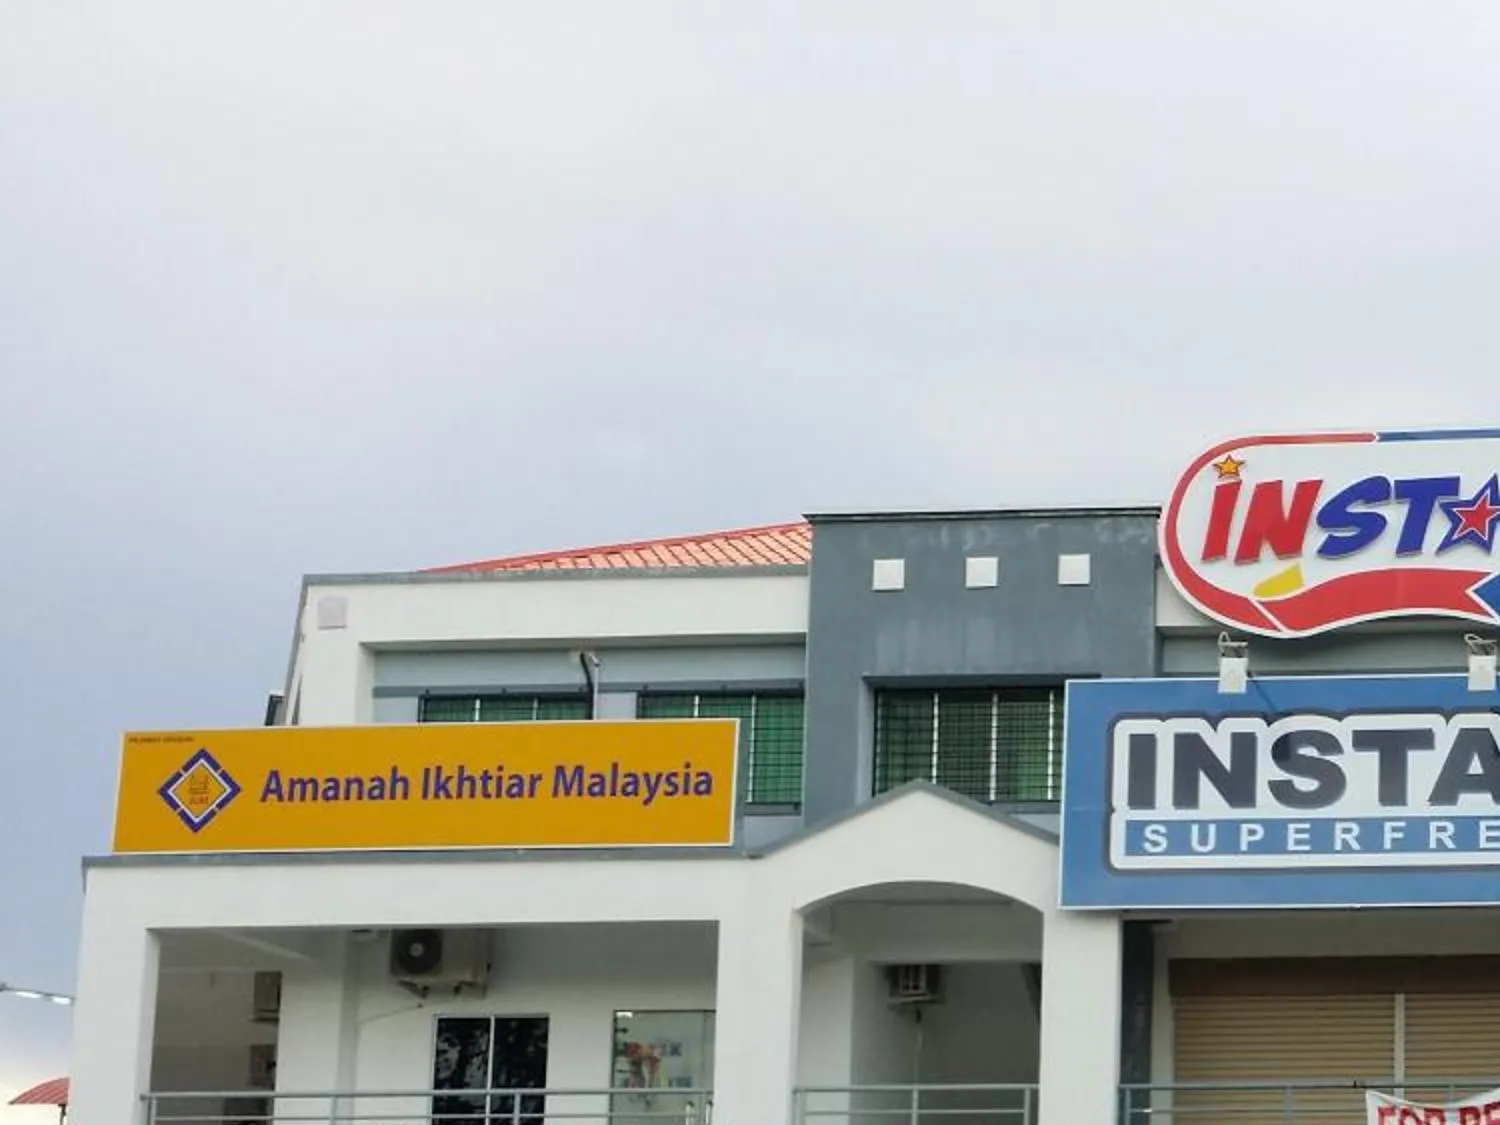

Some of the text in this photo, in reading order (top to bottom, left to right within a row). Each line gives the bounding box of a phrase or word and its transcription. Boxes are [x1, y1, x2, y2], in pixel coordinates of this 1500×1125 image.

[260, 761, 713, 806] Amanah Ikhtiar Malaysia
